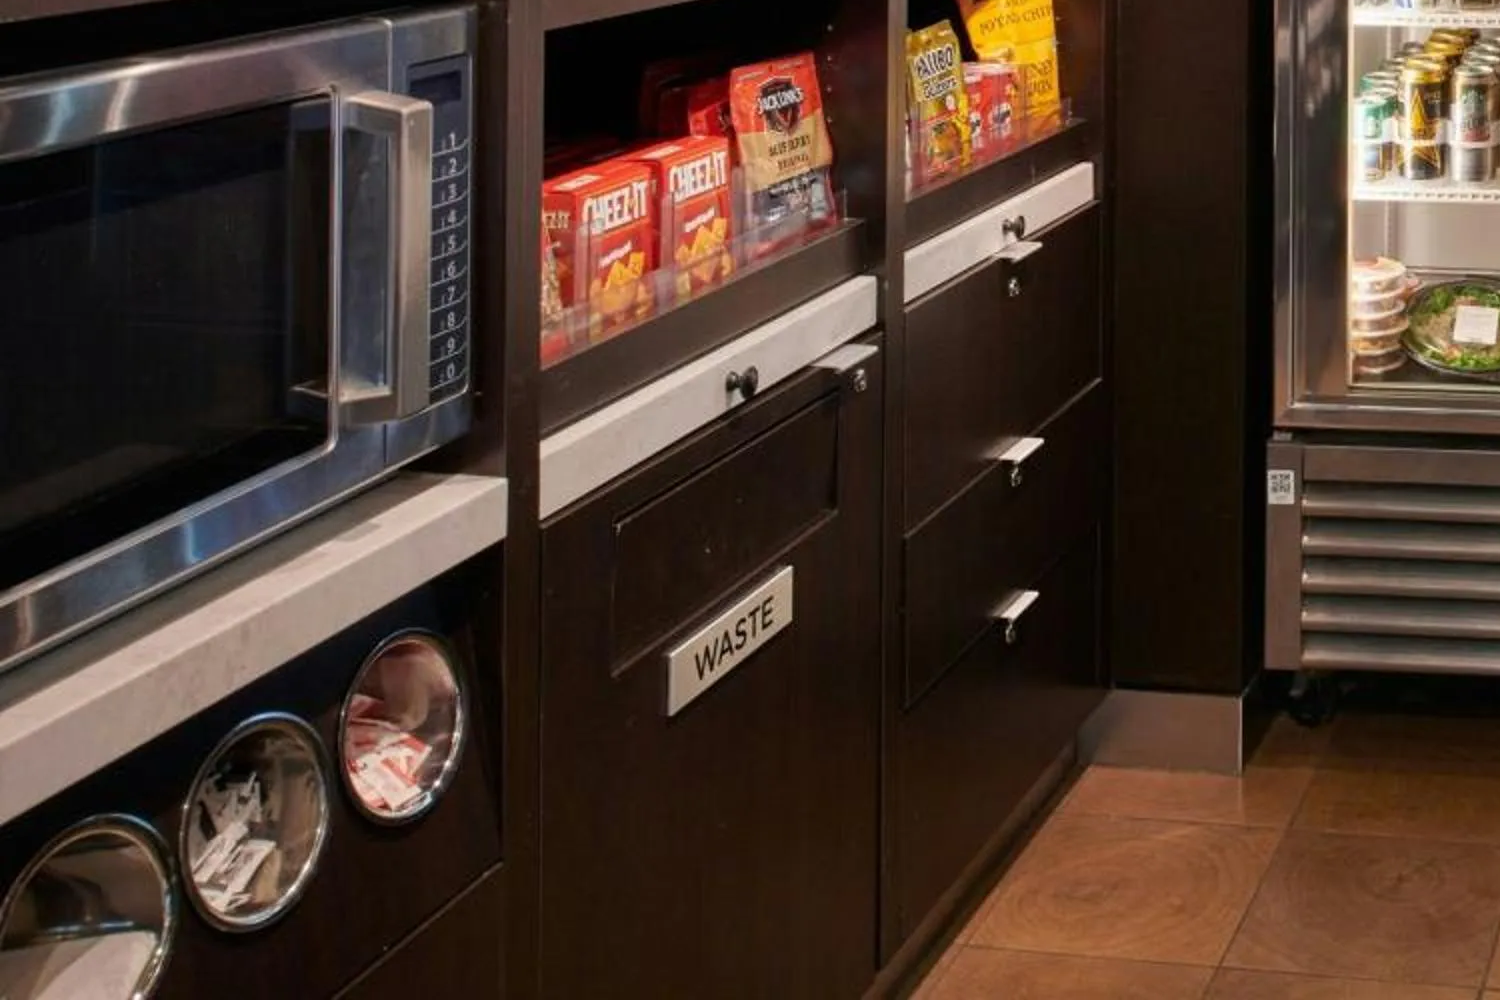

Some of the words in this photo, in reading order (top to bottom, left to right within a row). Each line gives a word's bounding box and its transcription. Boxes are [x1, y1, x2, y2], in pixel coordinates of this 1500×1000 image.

[669, 151, 728, 206] CHEEZ-IT
[583, 179, 649, 238] CHEEZ-IT
[694, 595, 774, 681] WASTE
